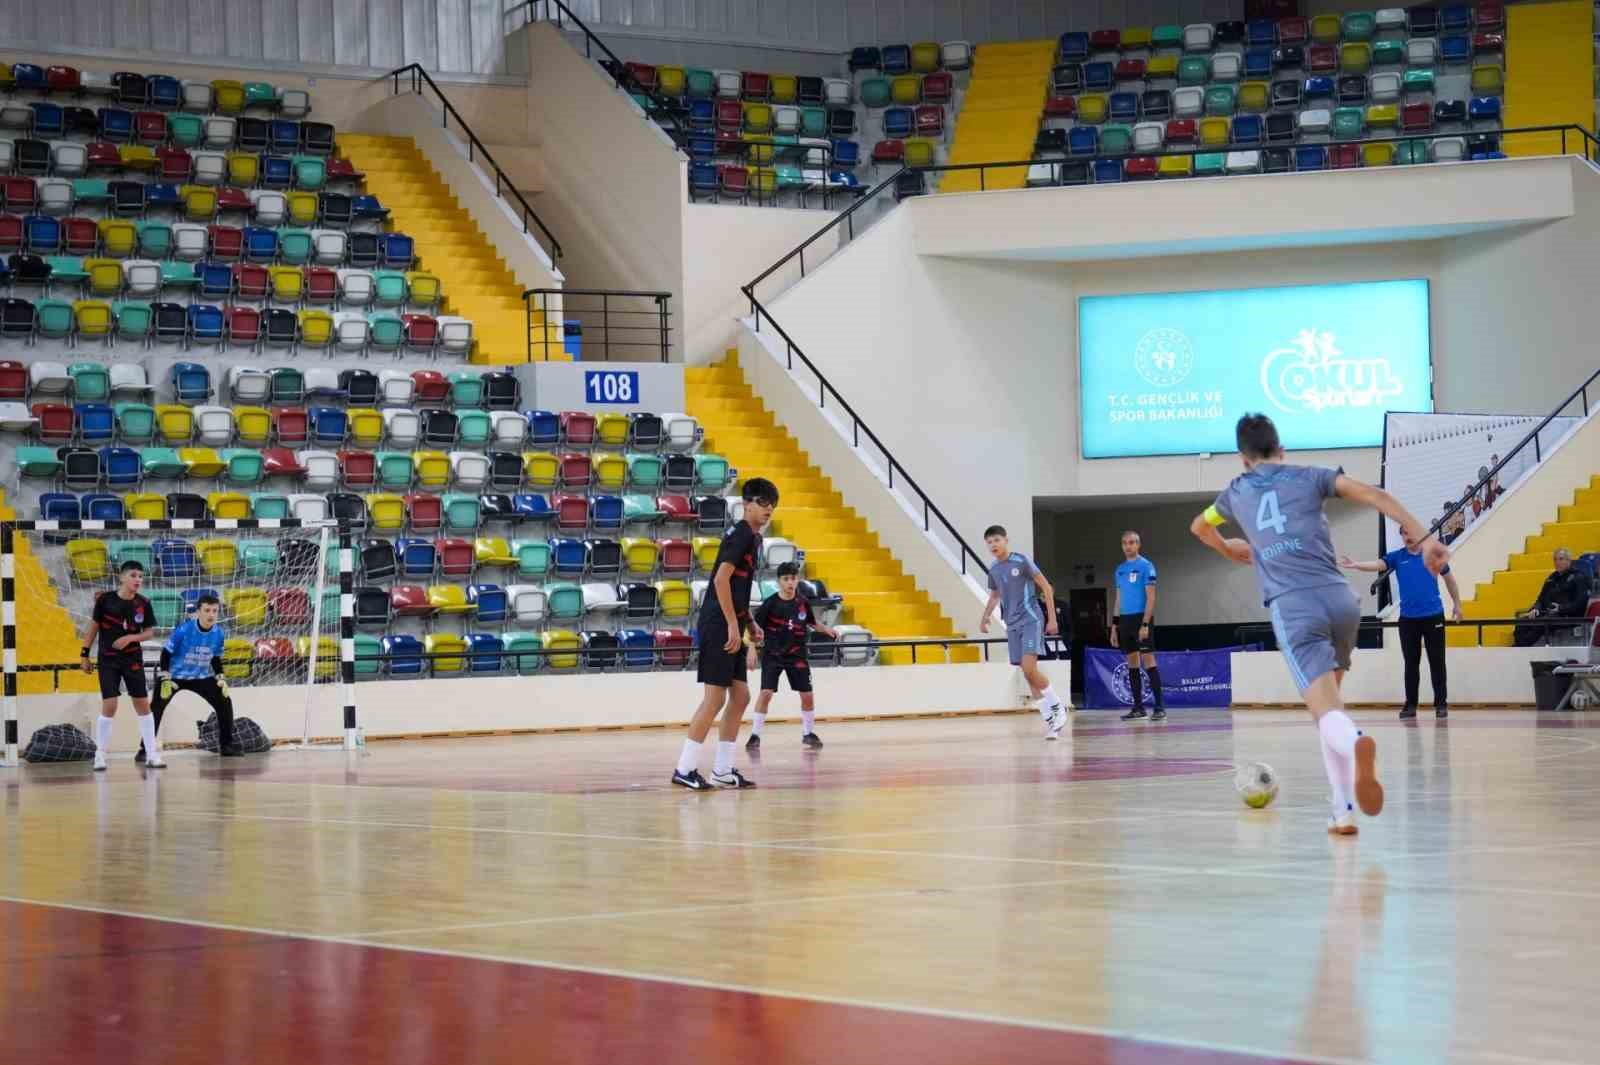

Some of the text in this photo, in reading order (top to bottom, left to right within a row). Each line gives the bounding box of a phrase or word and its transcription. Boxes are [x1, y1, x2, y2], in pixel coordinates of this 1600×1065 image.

[590, 373, 632, 401] 108
[1107, 392, 1132, 406] T.C.
[1203, 390, 1223, 403] VE
[1109, 409, 1145, 423] SPOR
[1256, 489, 1288, 535] 4
